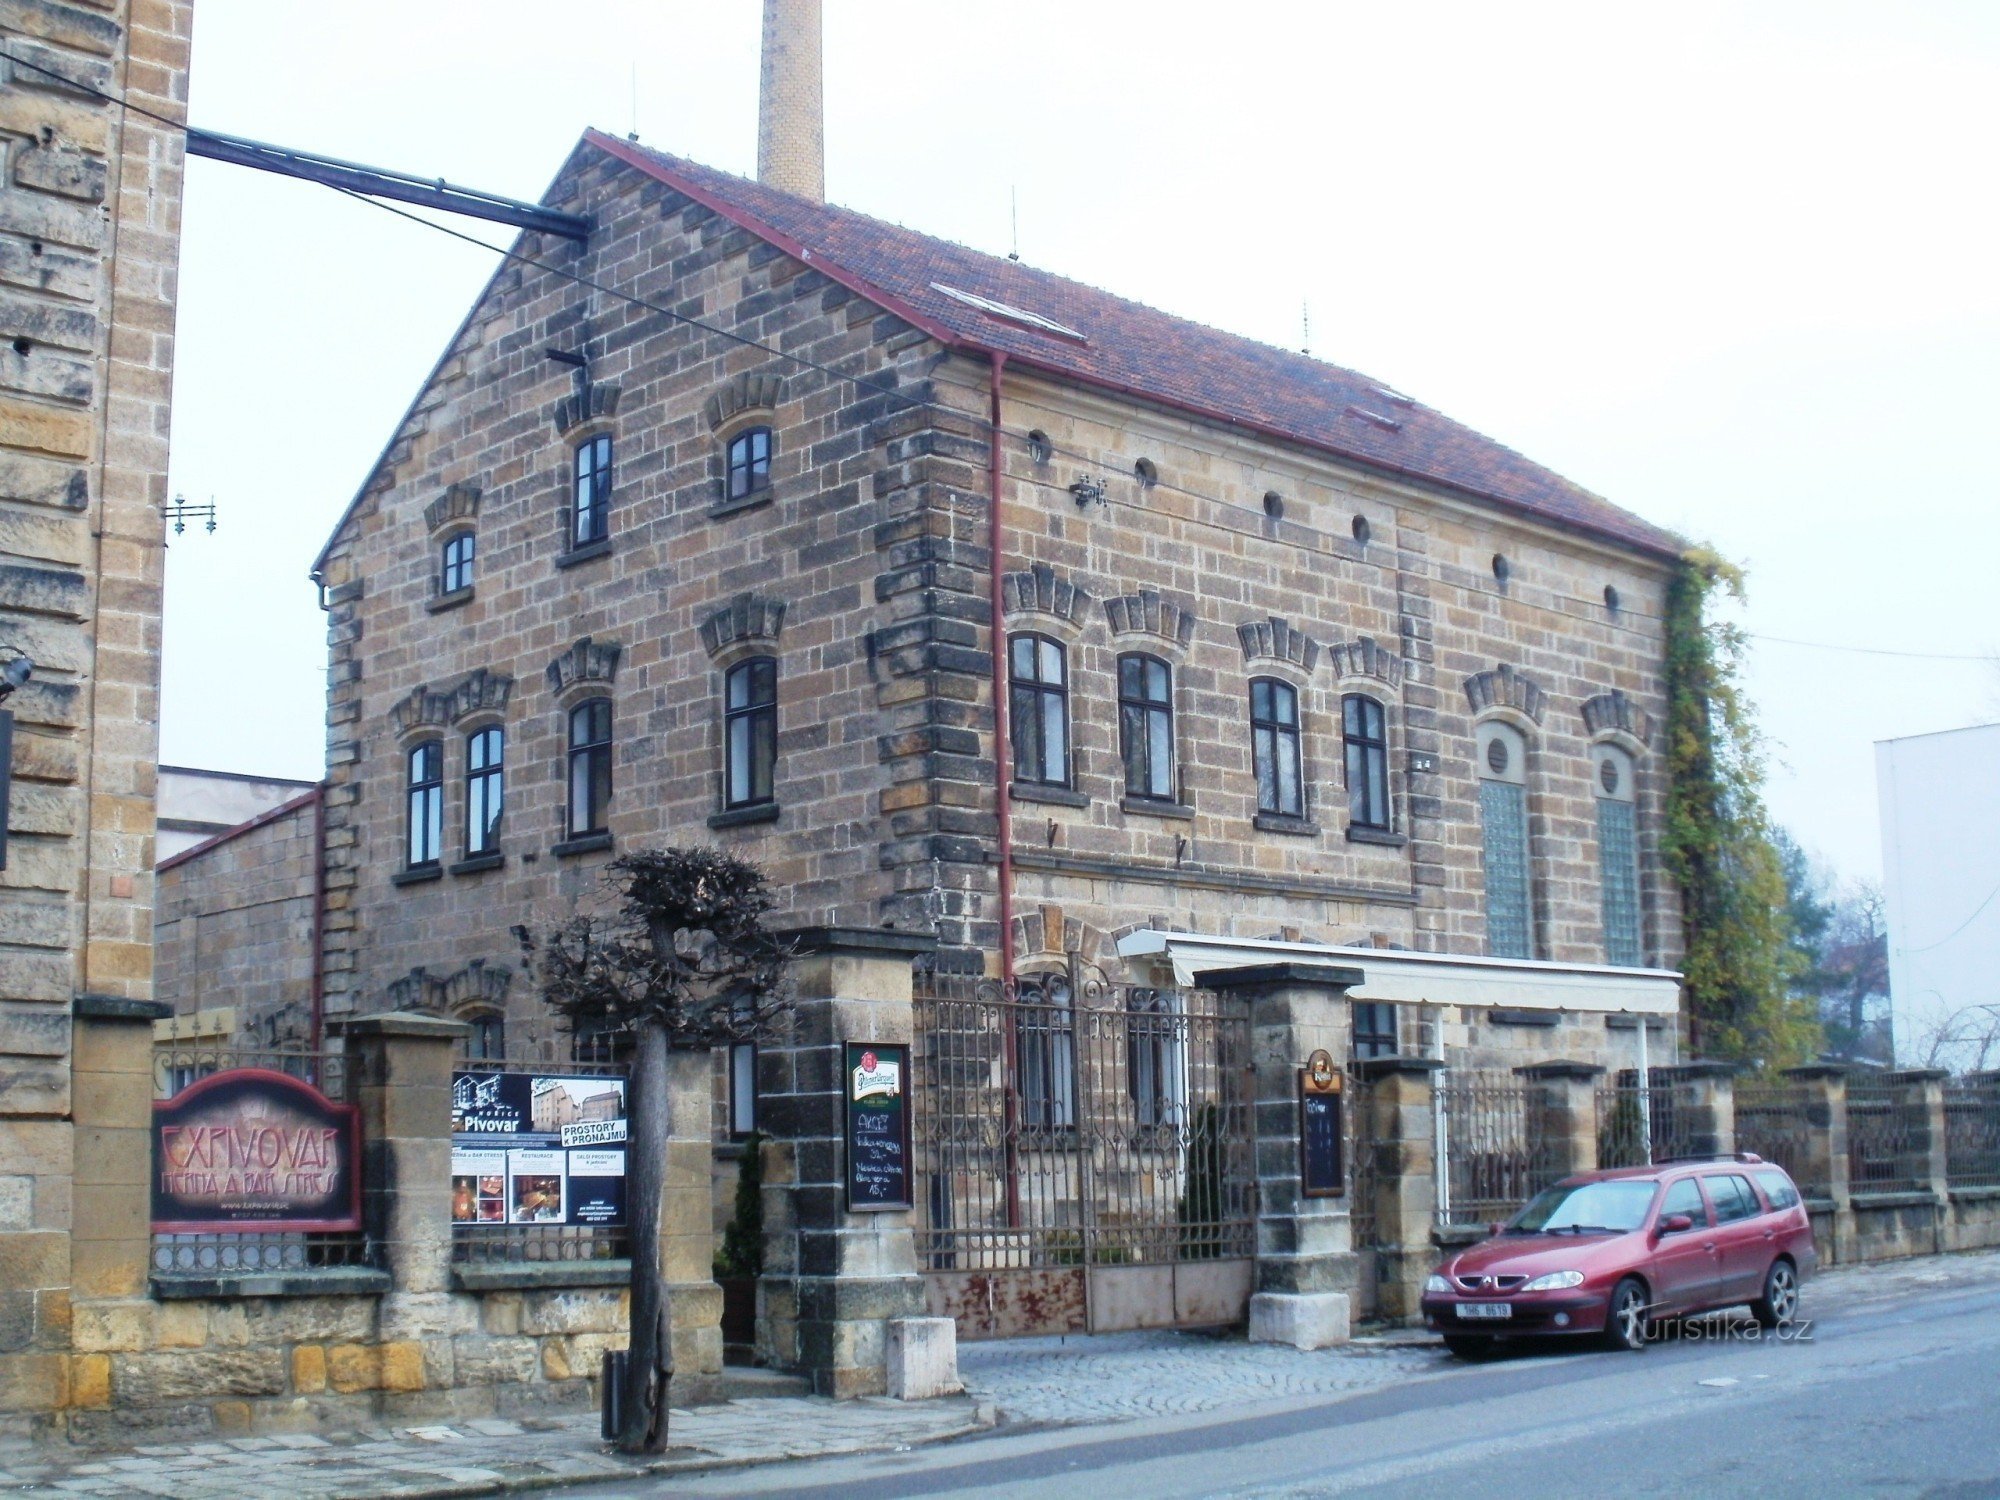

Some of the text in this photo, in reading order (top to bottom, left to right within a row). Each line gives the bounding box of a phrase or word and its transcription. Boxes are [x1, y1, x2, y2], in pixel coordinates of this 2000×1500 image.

[464, 1116, 519, 1132] Pivovar
[564, 1122, 615, 1136] PROSTORY
[223, 1173, 239, 1194] A
